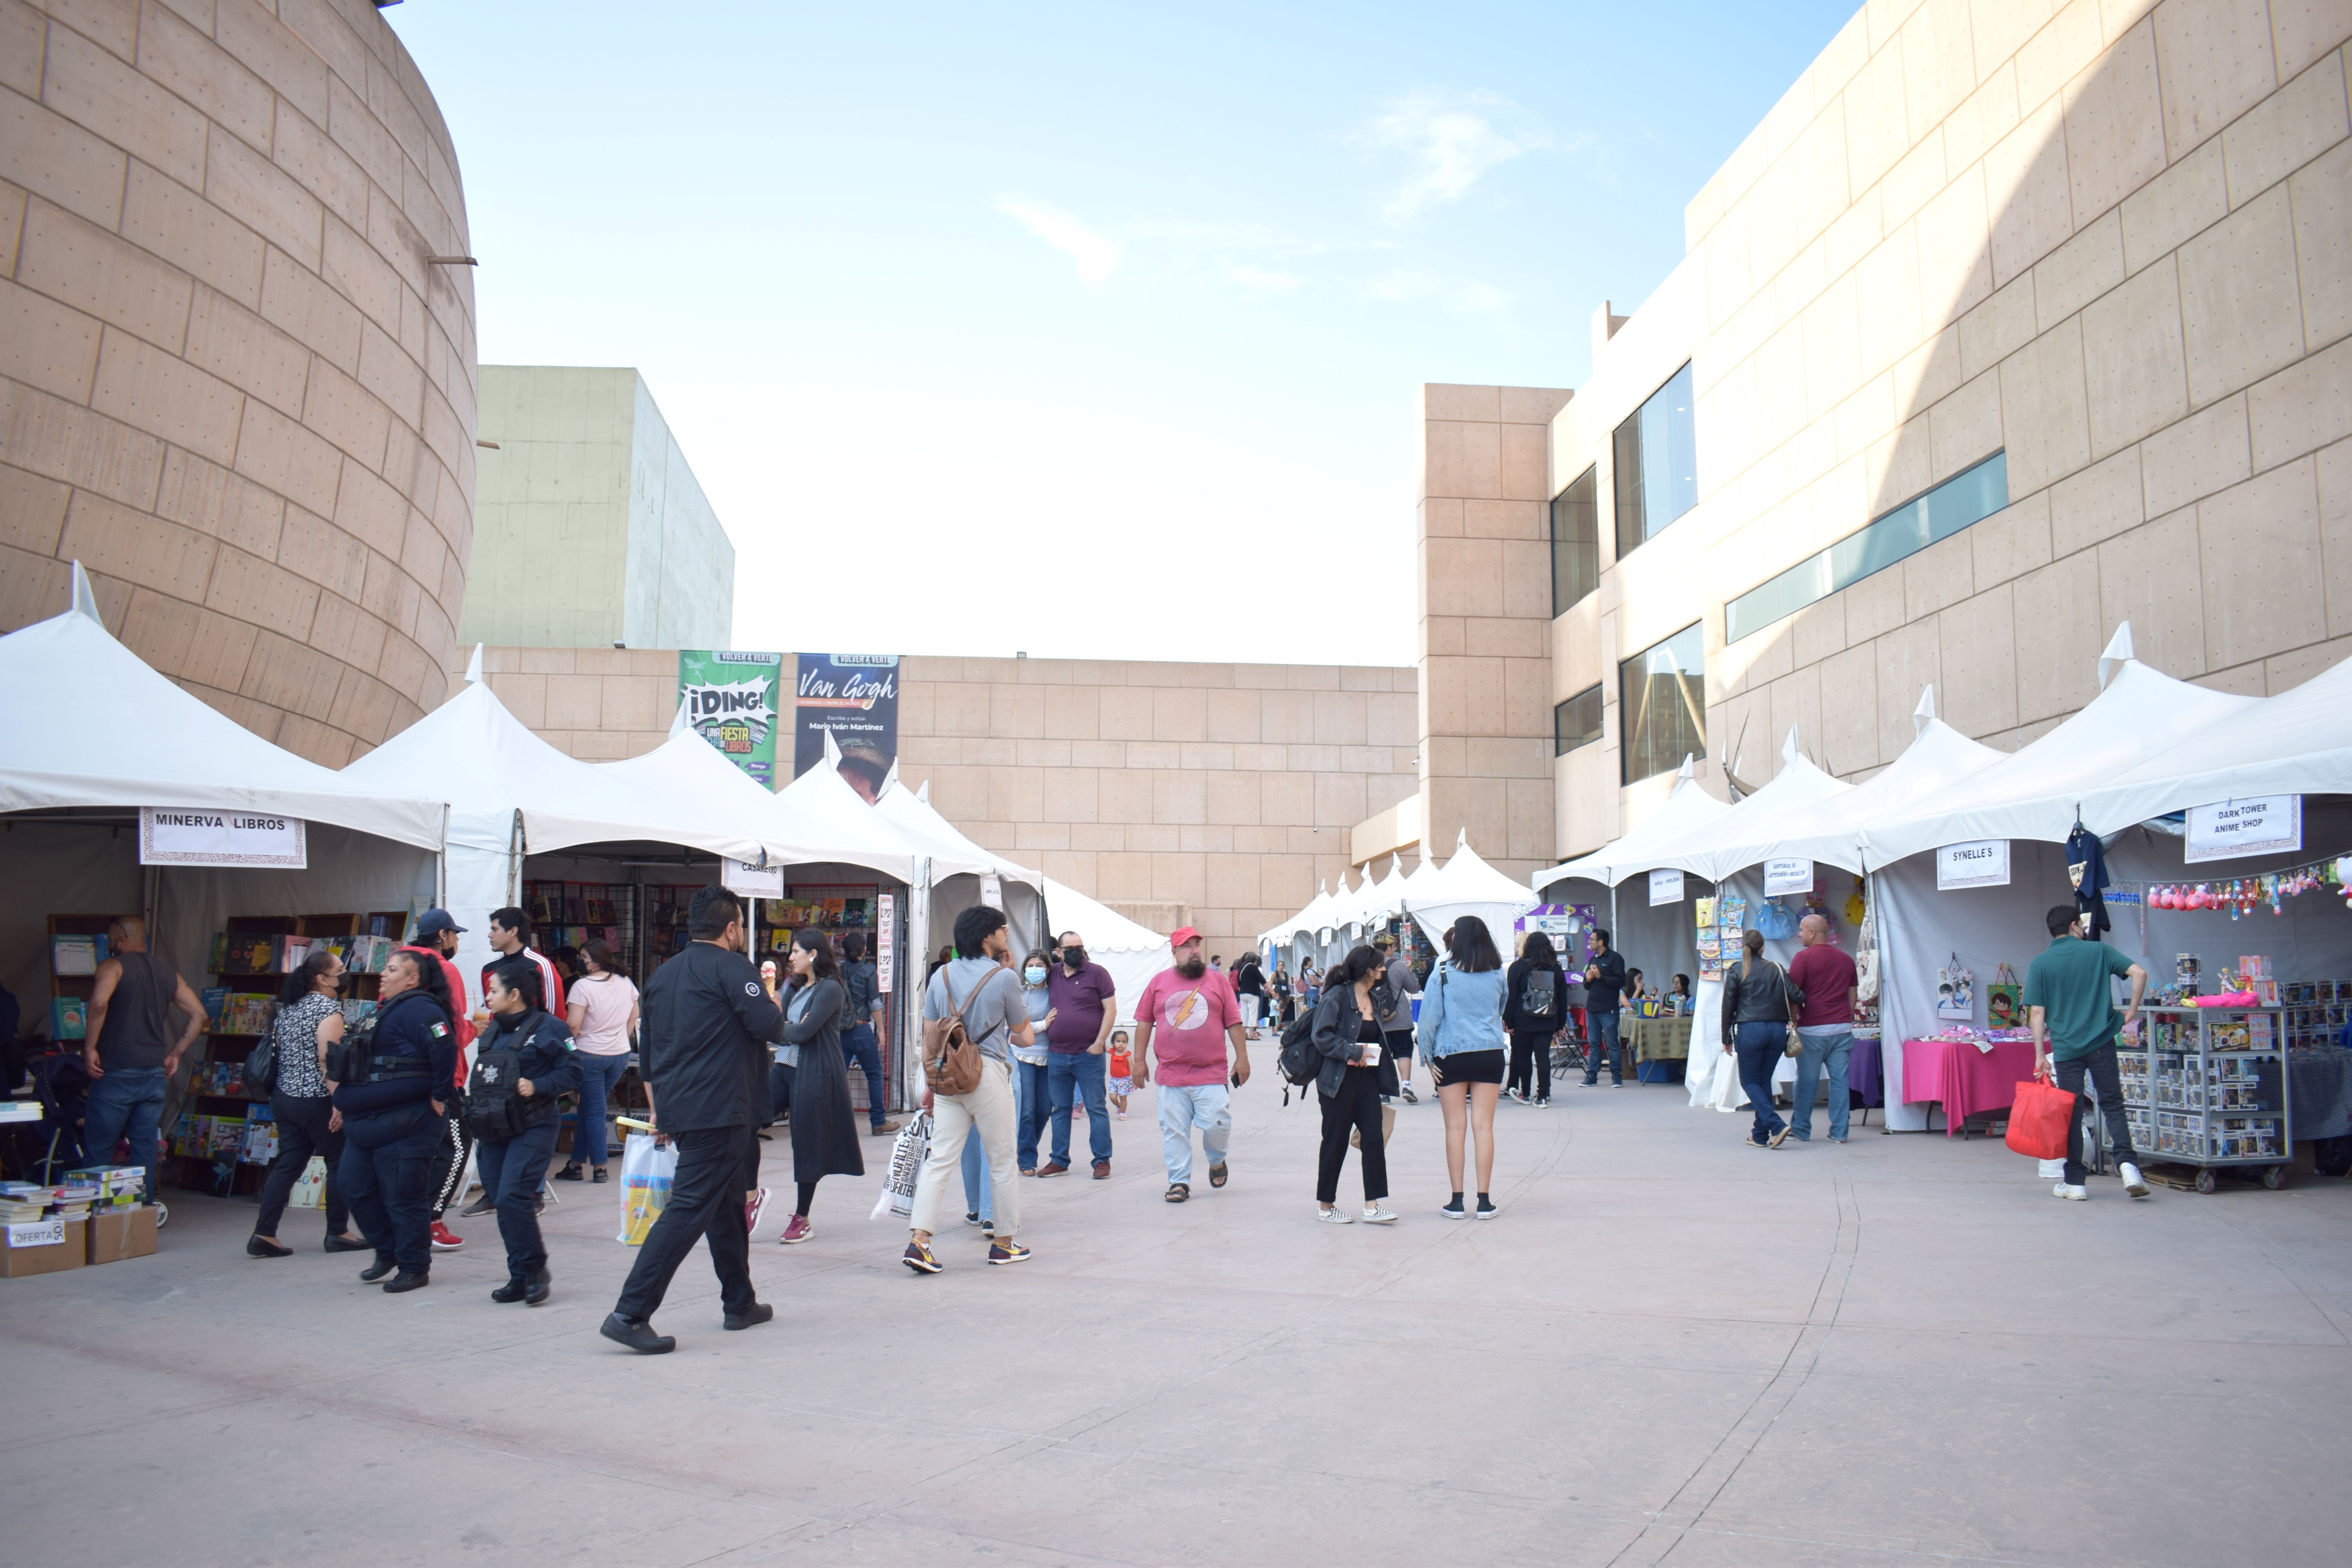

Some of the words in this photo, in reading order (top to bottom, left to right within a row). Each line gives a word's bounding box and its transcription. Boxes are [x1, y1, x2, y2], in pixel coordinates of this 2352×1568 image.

[722, 652, 746, 661] VOLVER
[753, 653, 773, 662] VERTE
[840, 655, 864, 663] VOLVER
[871, 656, 891, 664] VERTE
[799, 668, 837, 698] Van
[842, 673, 898, 710] Gogh
[690, 689, 764, 714] ¡DING!
[707, 728, 720, 737] UNA
[720, 727, 748, 741] FIESTA
[726, 741, 751, 753] LIBROS
[2218, 809, 2240, 819] DARK
[2241, 804, 2267, 814] TOWER
[156, 814, 224, 828] MINERVA
[233, 818, 285, 831] LIBROS
[2215, 823, 2239, 833] ANIME
[2242, 818, 2263, 828] SHOP
[16, 1231, 53, 1242] OFERTA
[53, 1221, 64, 1240] 50%
